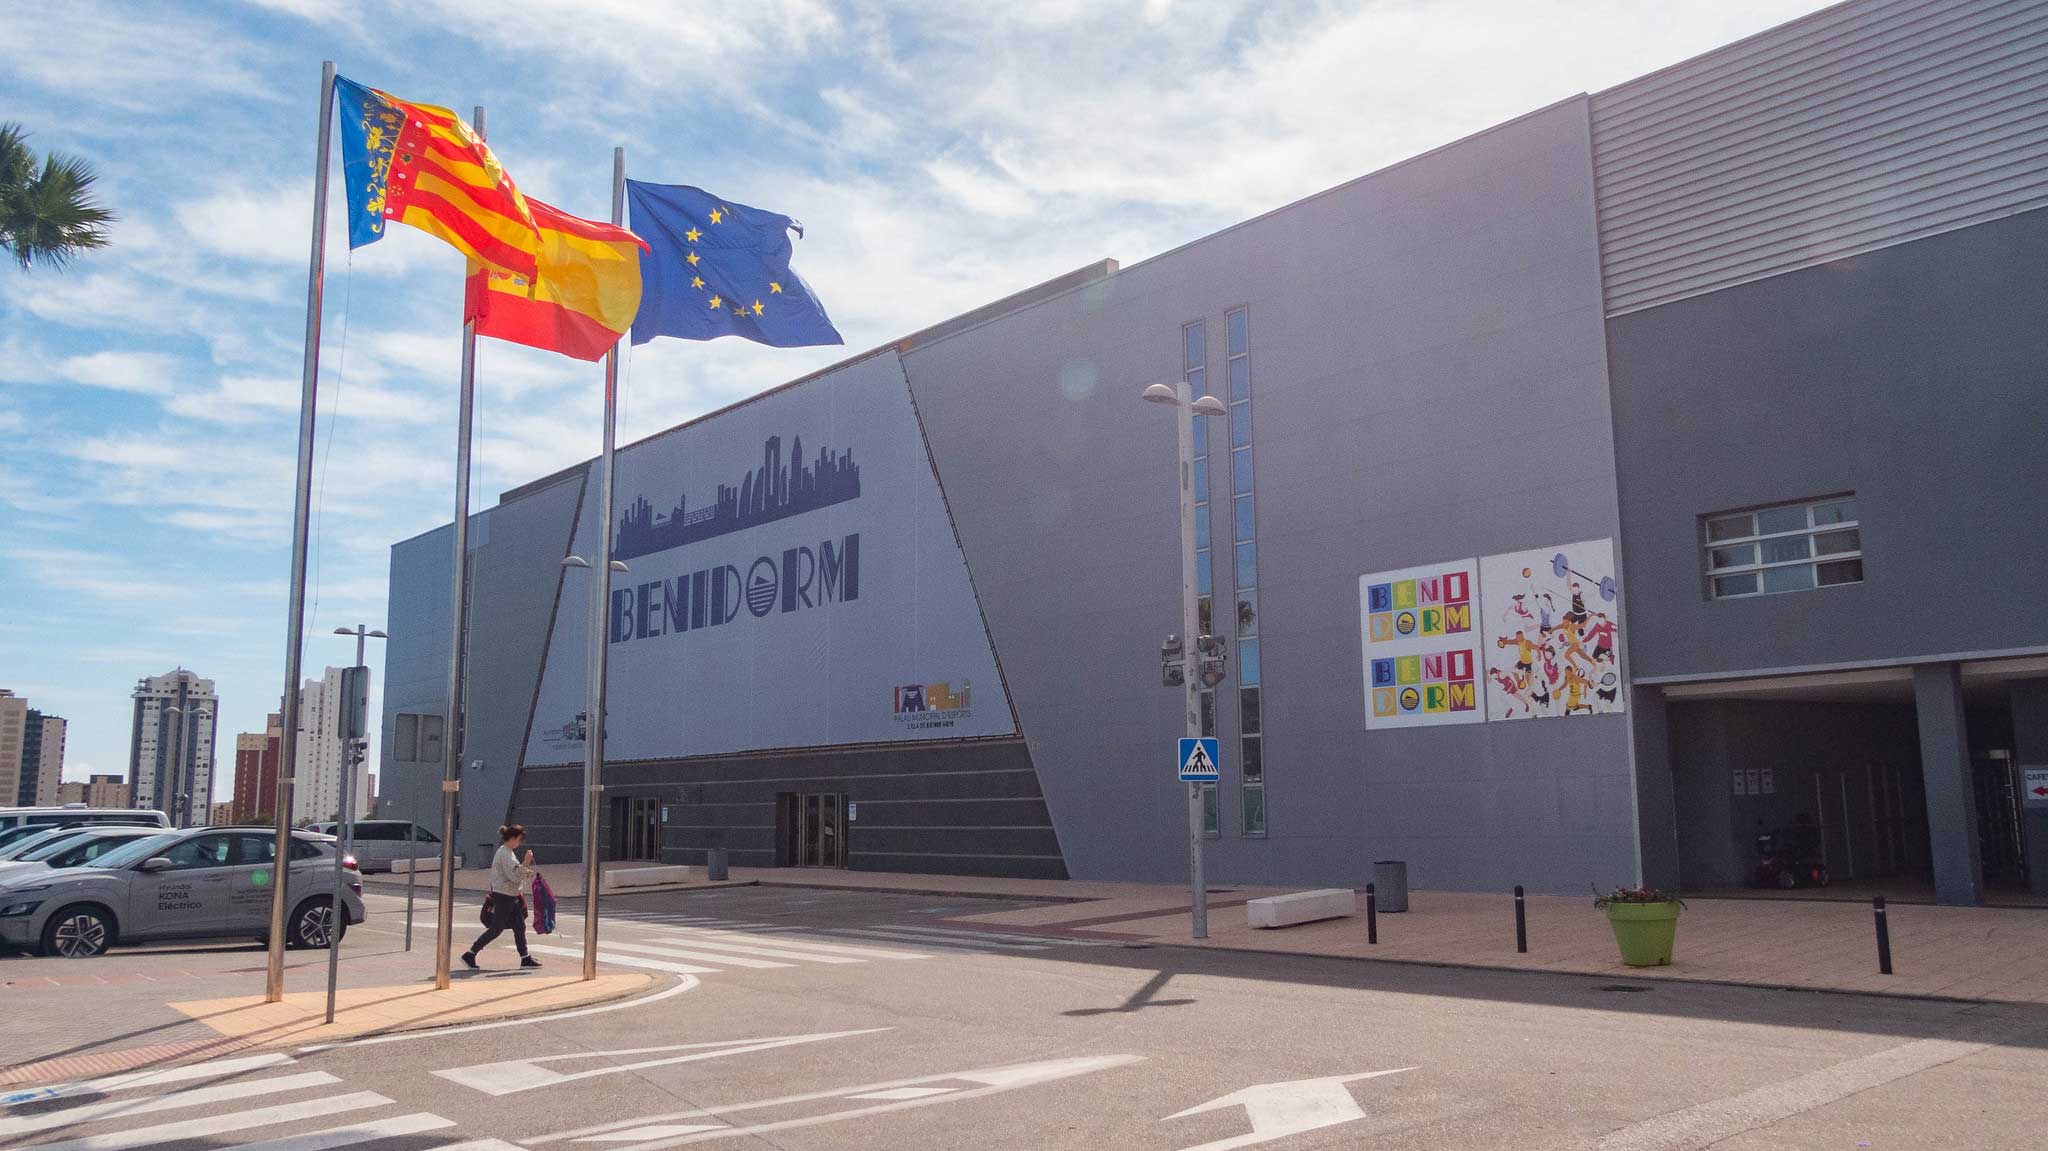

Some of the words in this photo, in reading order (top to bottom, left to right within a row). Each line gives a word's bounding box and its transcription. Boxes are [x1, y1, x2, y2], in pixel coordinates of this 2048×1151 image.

[611, 533, 859, 643] BENIDORM
[1371, 575, 1461, 609] BENI
[1373, 604, 1470, 637] DORM
[1375, 653, 1465, 682] BENI
[1376, 683, 1475, 713] DORM
[158, 901, 202, 911] Eléctrico
[159, 892, 189, 900] KONA
